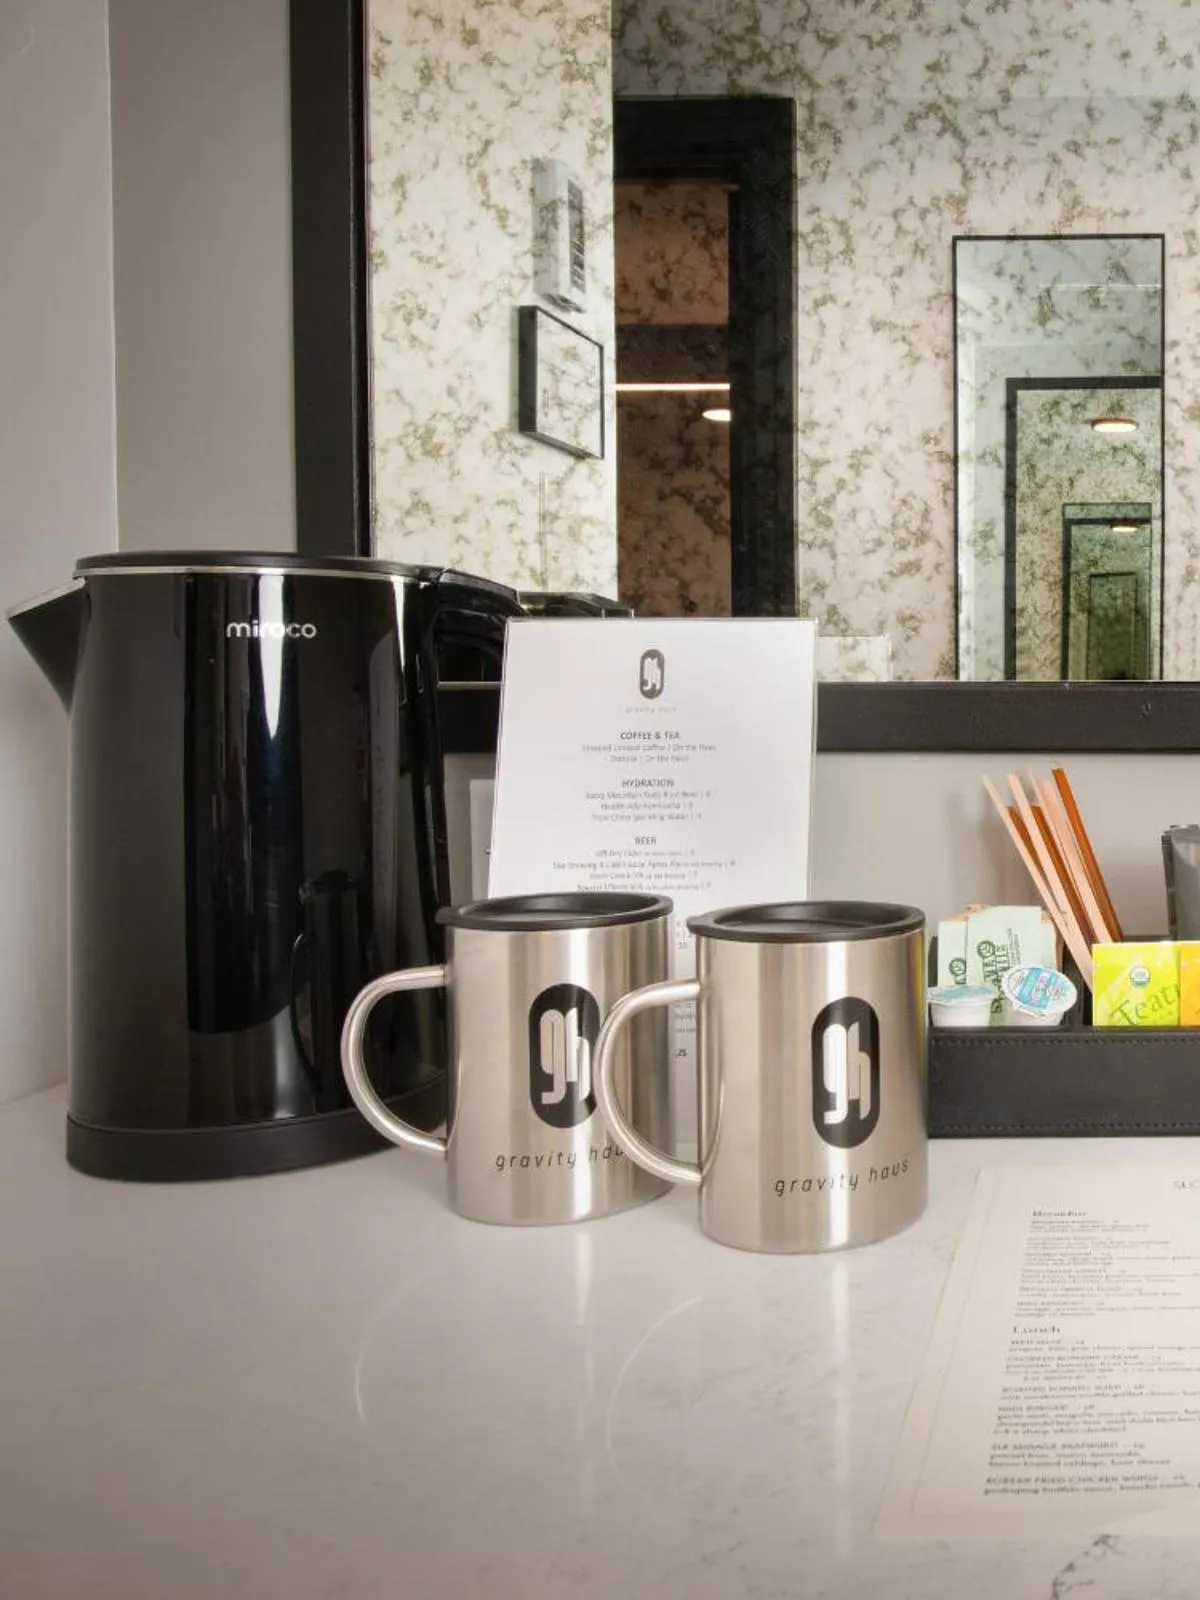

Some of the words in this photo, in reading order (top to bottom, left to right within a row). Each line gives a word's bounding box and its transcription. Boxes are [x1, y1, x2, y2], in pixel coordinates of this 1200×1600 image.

[227, 619, 317, 639] miroco
[620, 731, 652, 740] COFFEE
[664, 731, 680, 740] TEA
[622, 779, 674, 788] HYDRATION
[634, 837, 657, 845] BEER
[495, 1151, 576, 1172] gravity
[589, 1145, 623, 1161] hau
[775, 1174, 859, 1197] gravity
[869, 1158, 908, 1182] haus
[1012, 1325, 1061, 1334] Lunch
